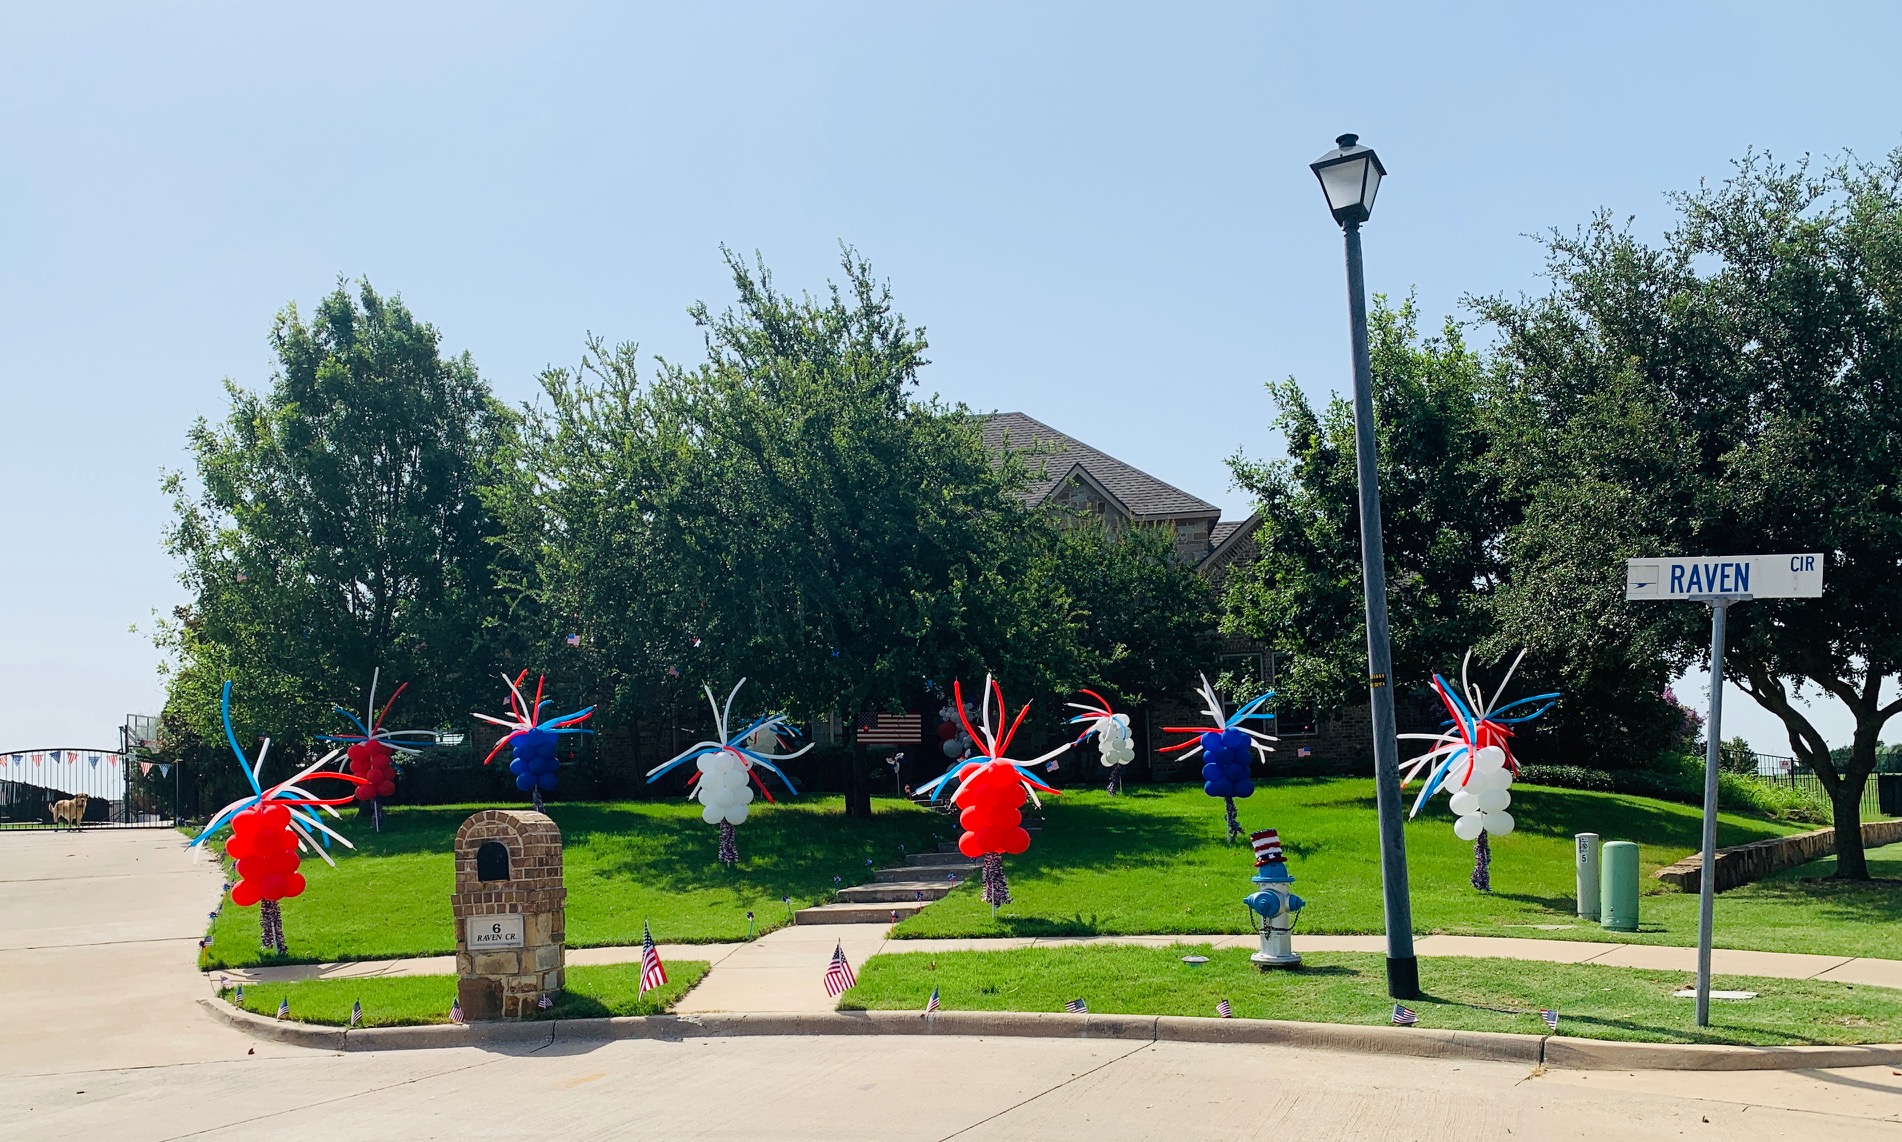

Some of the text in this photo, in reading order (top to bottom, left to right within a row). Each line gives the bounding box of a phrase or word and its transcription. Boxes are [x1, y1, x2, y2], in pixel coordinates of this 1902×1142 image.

[1670, 556, 1815, 594] RAVEN CIR
[1582, 854, 1586, 862] 5
[492, 923, 501, 933] 6
[477, 933, 502, 941] RAVEN
